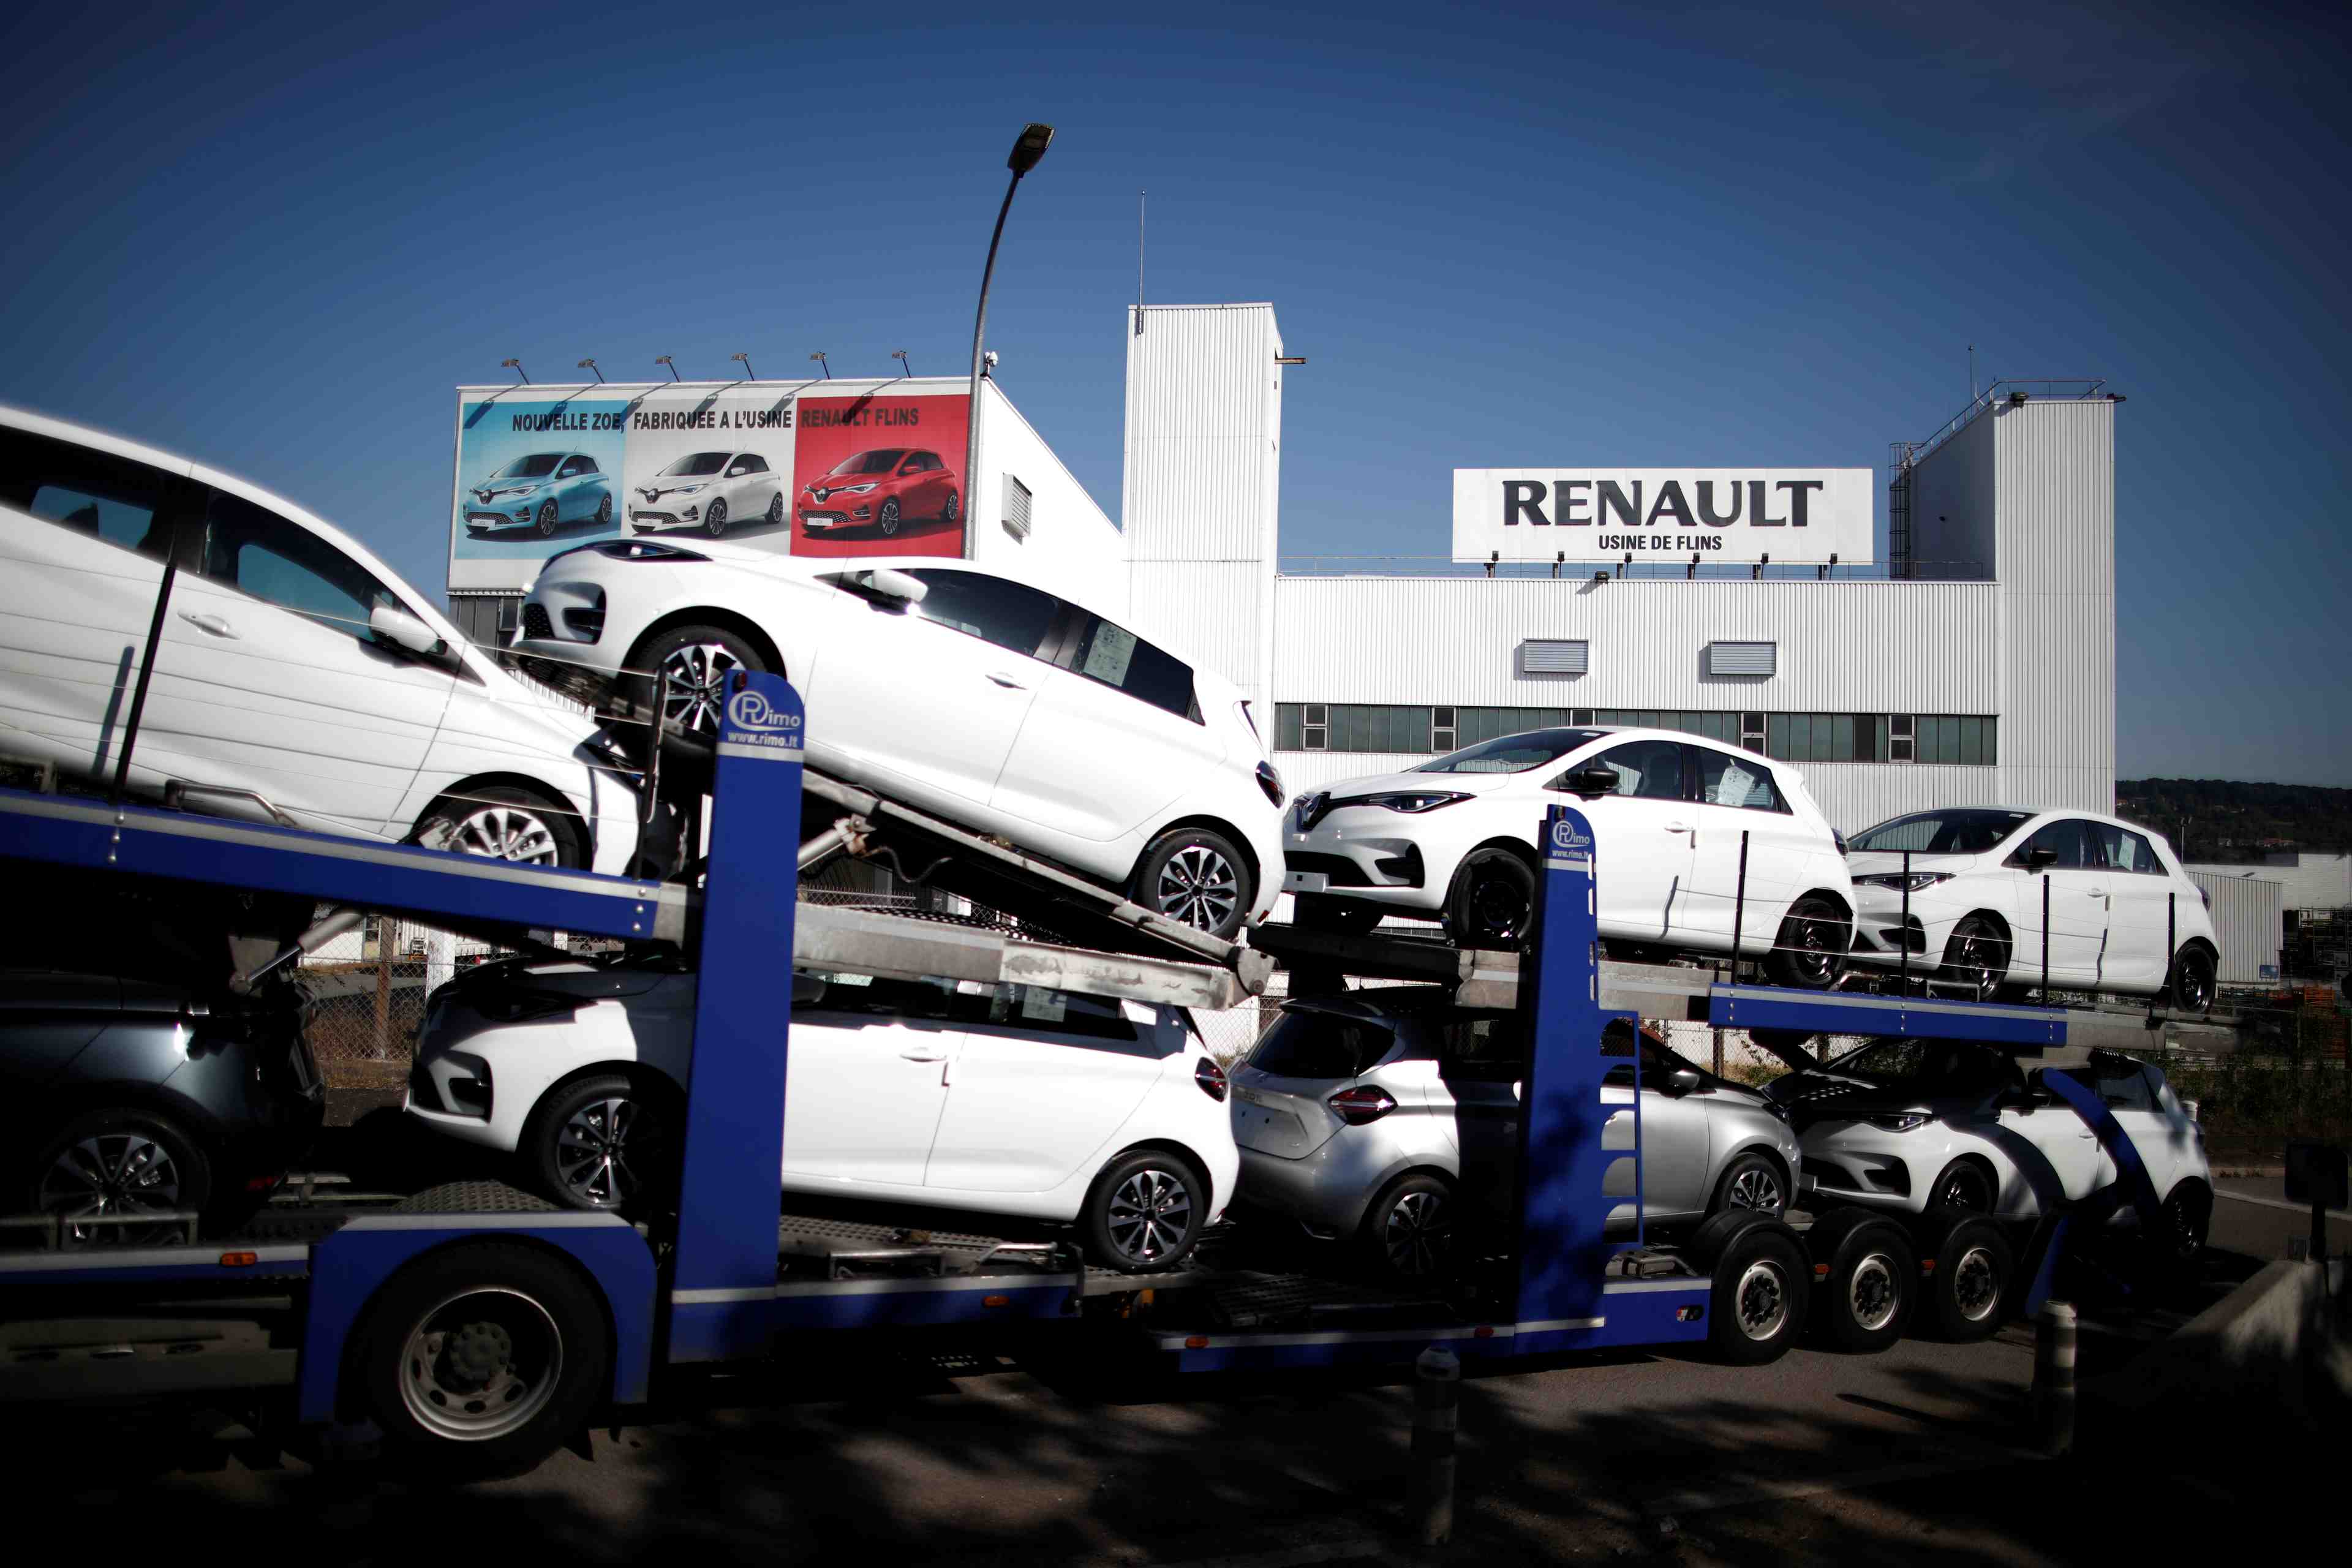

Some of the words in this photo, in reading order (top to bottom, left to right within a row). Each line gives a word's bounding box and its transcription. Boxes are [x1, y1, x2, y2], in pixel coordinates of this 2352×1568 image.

[513, 412, 588, 431] NOUVELLE
[633, 410, 715, 431] FABRIQUEE
[719, 411, 730, 429] A
[801, 409, 872, 428] RENAULT
[875, 408, 919, 426] FLINS
[1502, 480, 1823, 527] RENAULT
[1599, 535, 1646, 549] USINE
[1651, 535, 1672, 550] DE
[1676, 535, 1722, 550] FLINS
[728, 691, 801, 731] Rimo
[728, 733, 797, 747] www.rimo.it
[1552, 821, 1591, 848] Rimo
